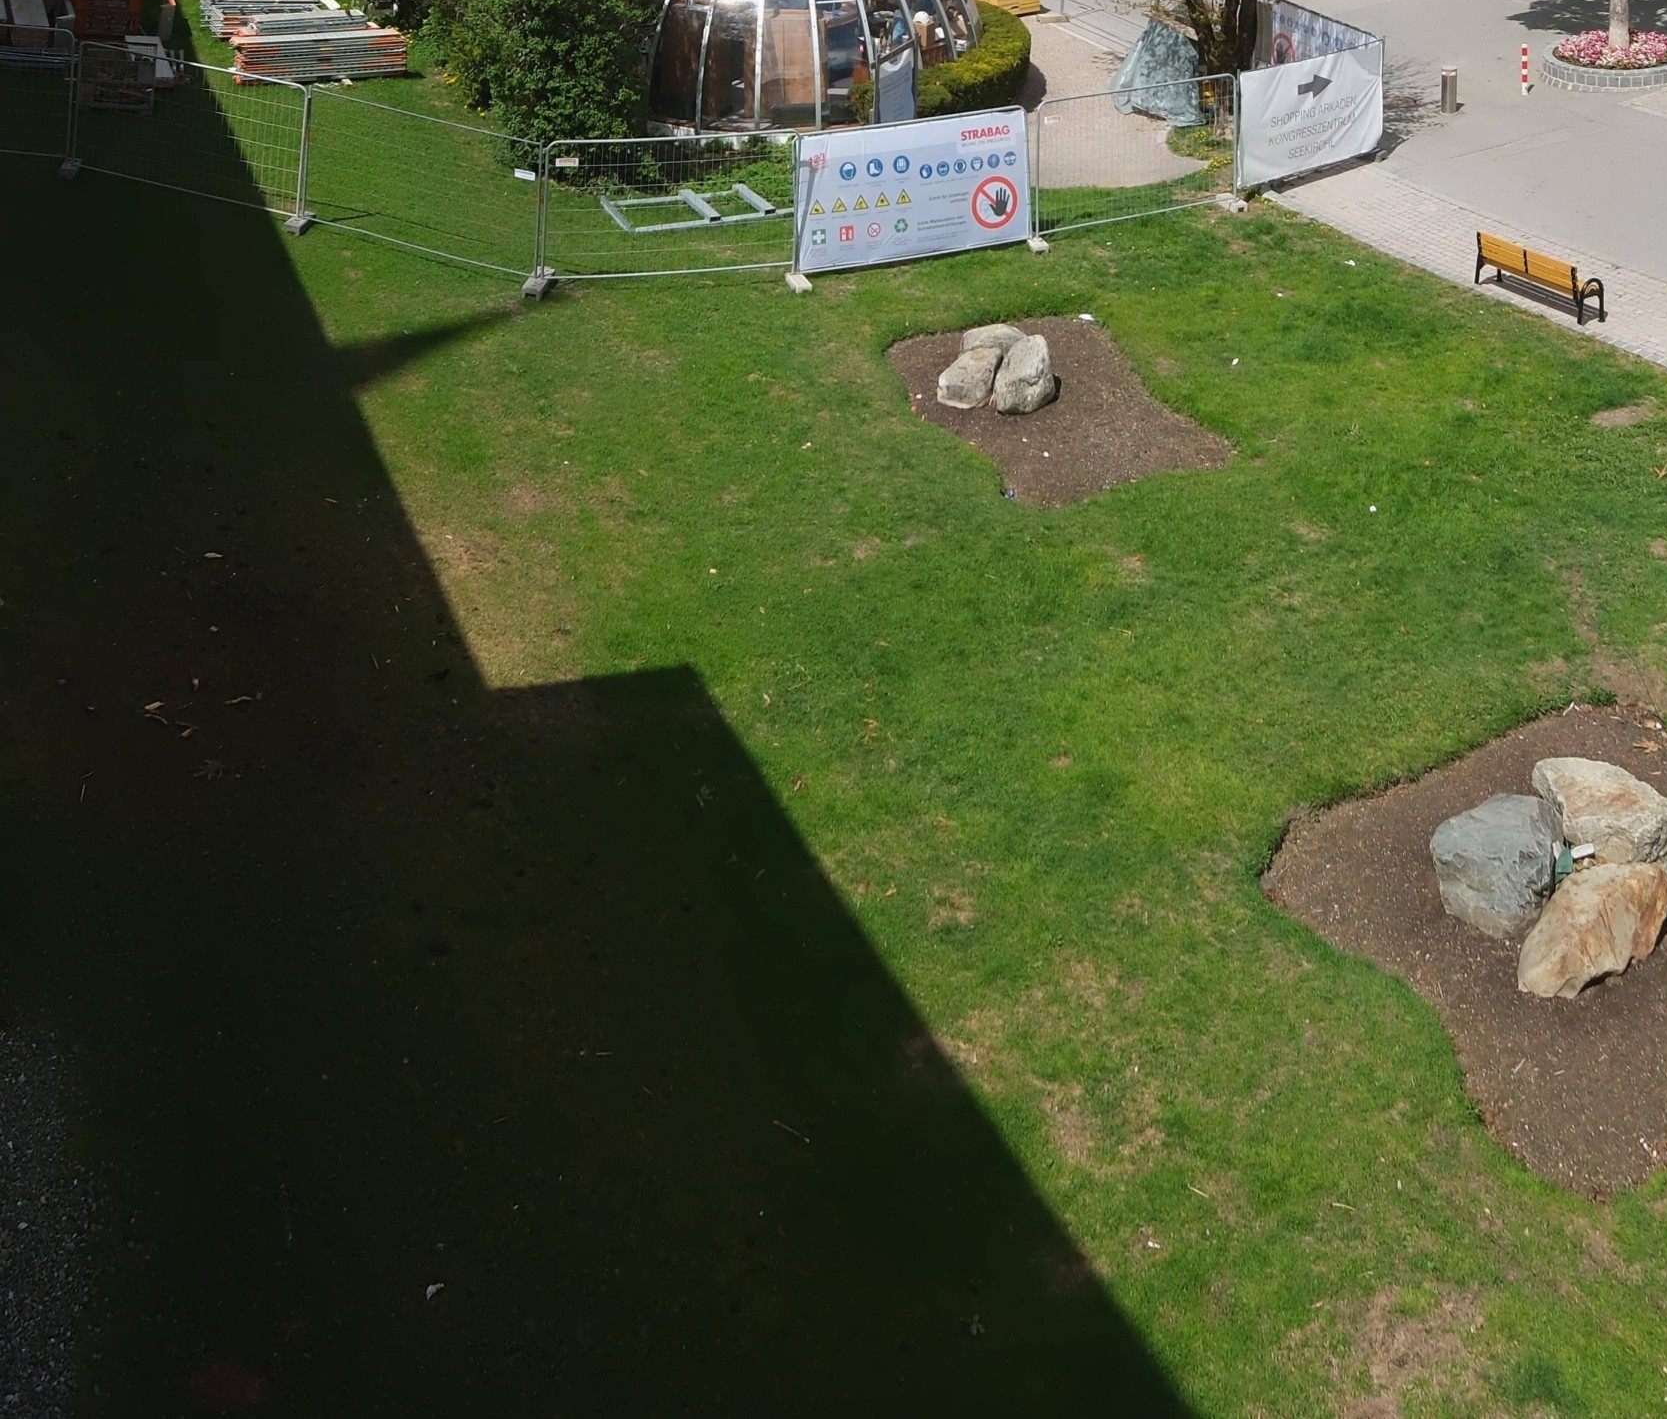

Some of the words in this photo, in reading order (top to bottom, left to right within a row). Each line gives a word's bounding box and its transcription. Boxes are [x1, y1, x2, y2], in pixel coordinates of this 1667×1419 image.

[1271, 106, 1316, 128] SHOPPING
[1318, 96, 1357, 115] ARKADEN
[961, 125, 1010, 141] STRABAG
[1268, 113, 1356, 147] KONGRESSZENTRUM
[1288, 137, 1336, 160] SEEKIRCHL
